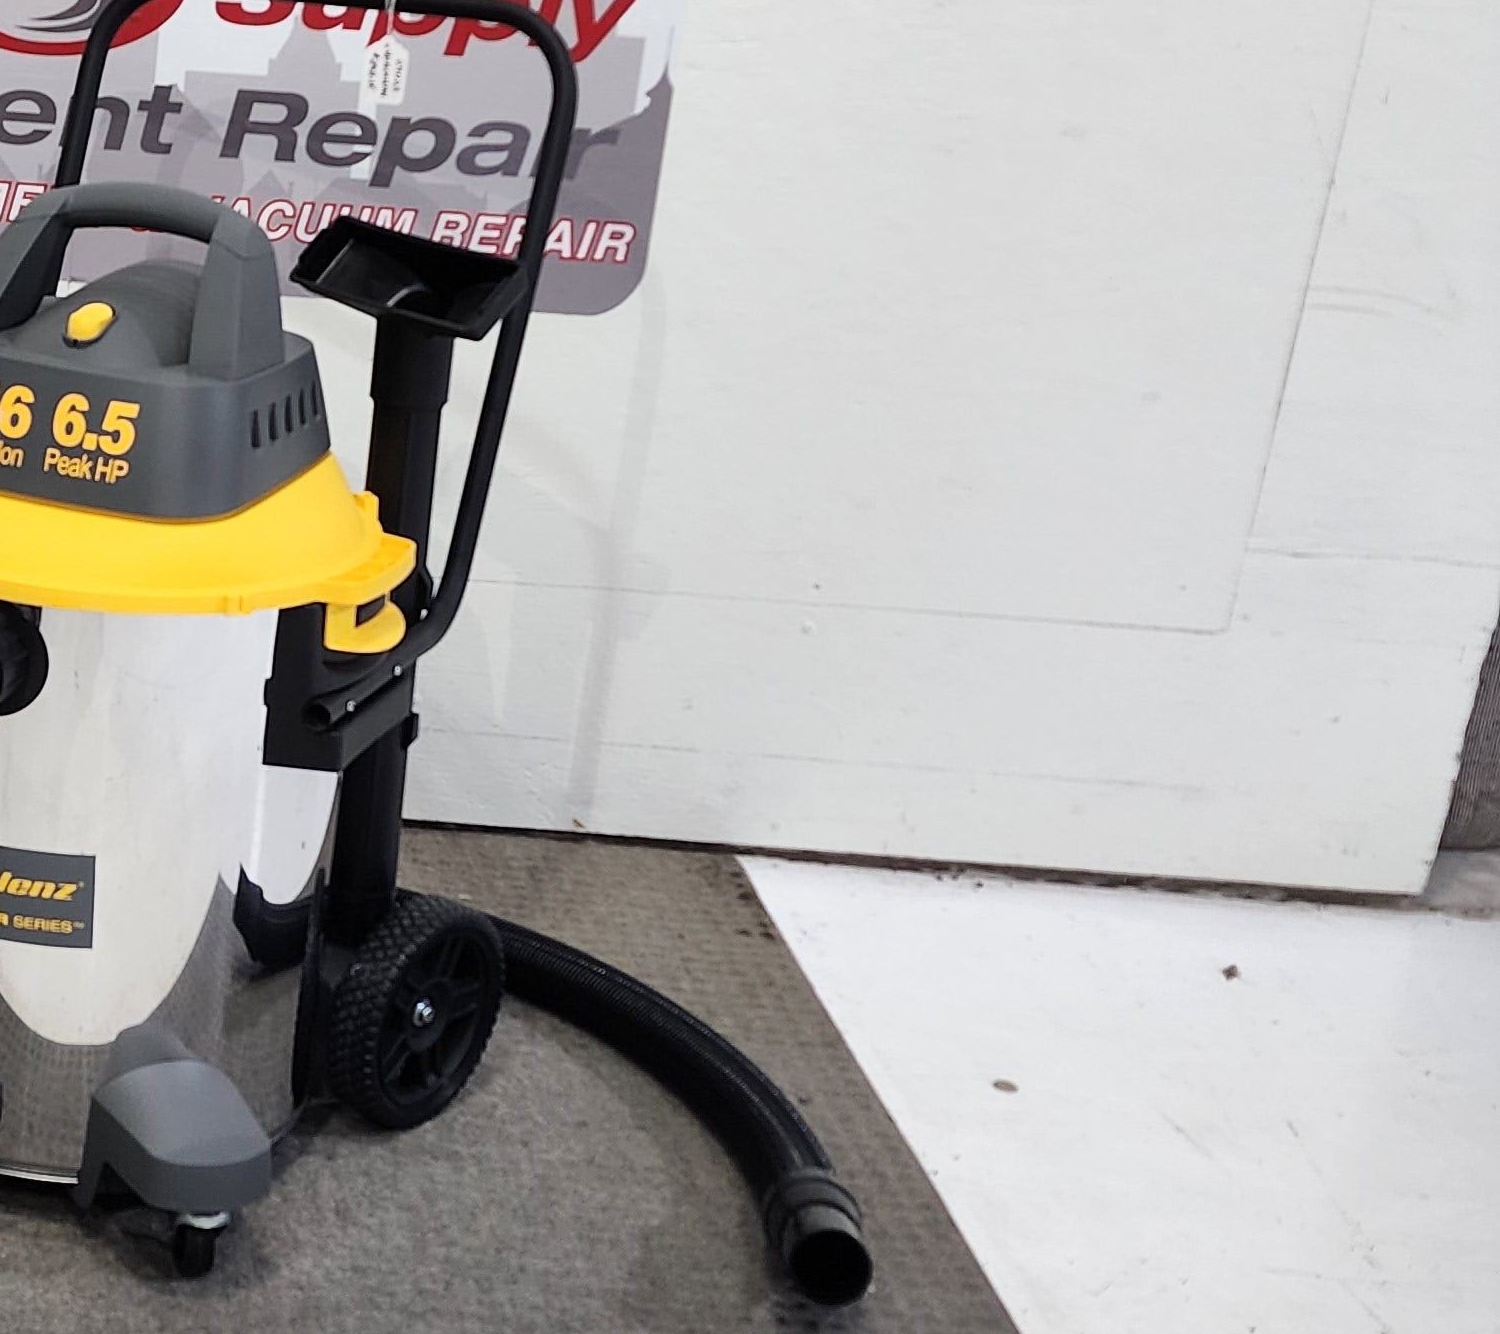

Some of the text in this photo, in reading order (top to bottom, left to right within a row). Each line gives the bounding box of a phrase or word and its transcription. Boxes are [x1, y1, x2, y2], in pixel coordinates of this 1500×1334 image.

[219, 89, 622, 188] Repar
[52, 392, 141, 457] 6.5
[43, 447, 93, 480] Peak
[94, 456, 130, 484] HP
